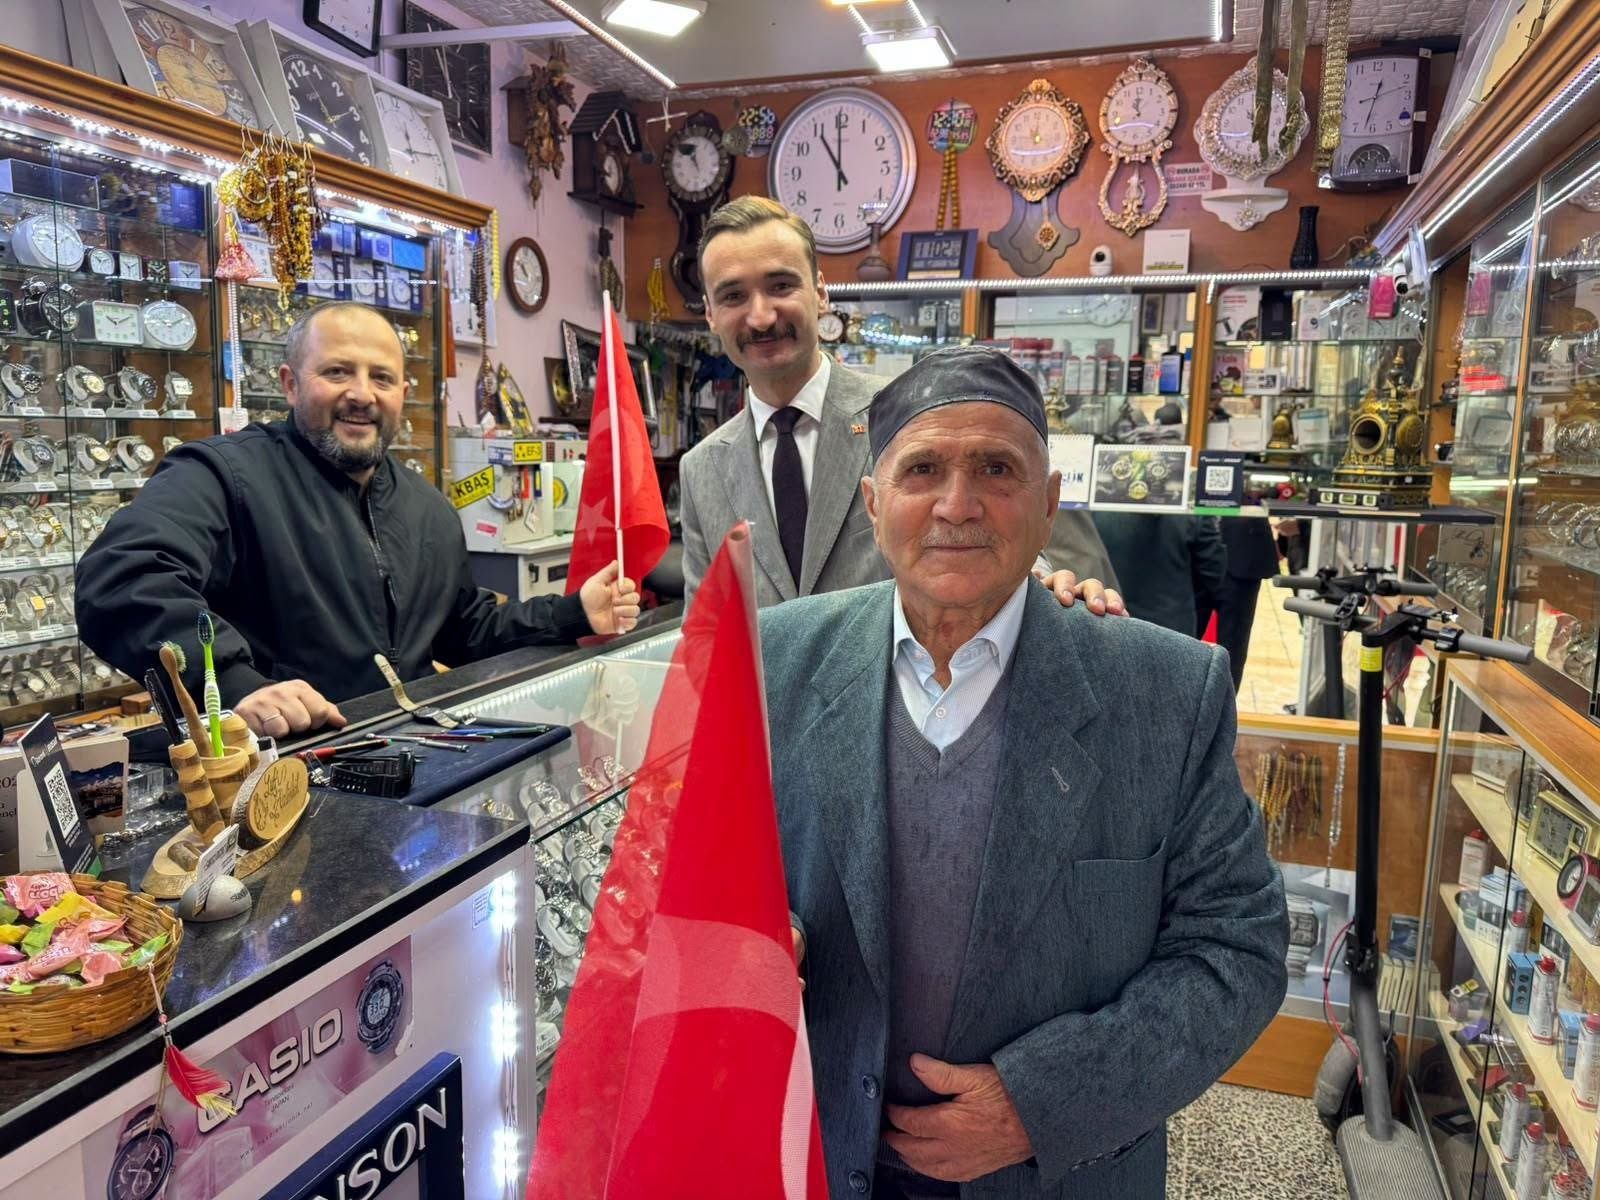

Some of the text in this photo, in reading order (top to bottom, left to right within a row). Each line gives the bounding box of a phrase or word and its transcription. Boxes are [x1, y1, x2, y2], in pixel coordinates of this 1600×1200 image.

[290, 60, 311, 78] 12
[312, 64, 324, 81] 1
[1355, 64, 1364, 75] 11
[1373, 61, 1383, 72] 12
[1403, 73, 1410, 84] 2
[331, 81, 345, 98] 2
[349, 106, 361, 122] 3
[738, 105, 776, 127] 22:56
[835, 113, 849, 129] 12
[1353, 122, 1359, 133] 7
[1369, 123, 1376, 133] 6
[1385, 120, 1393, 131] 5
[359, 129, 370, 145] 4
[874, 135, 886, 151] 2
[796, 141, 810, 157] 10
[358, 152, 371, 167] 5
[791, 166, 802, 182] 9
[796, 191, 807, 207] 8
[812, 208, 822, 223] 7
[834, 214, 845, 228] 6
[197, 1008, 344, 1134] CASIO
